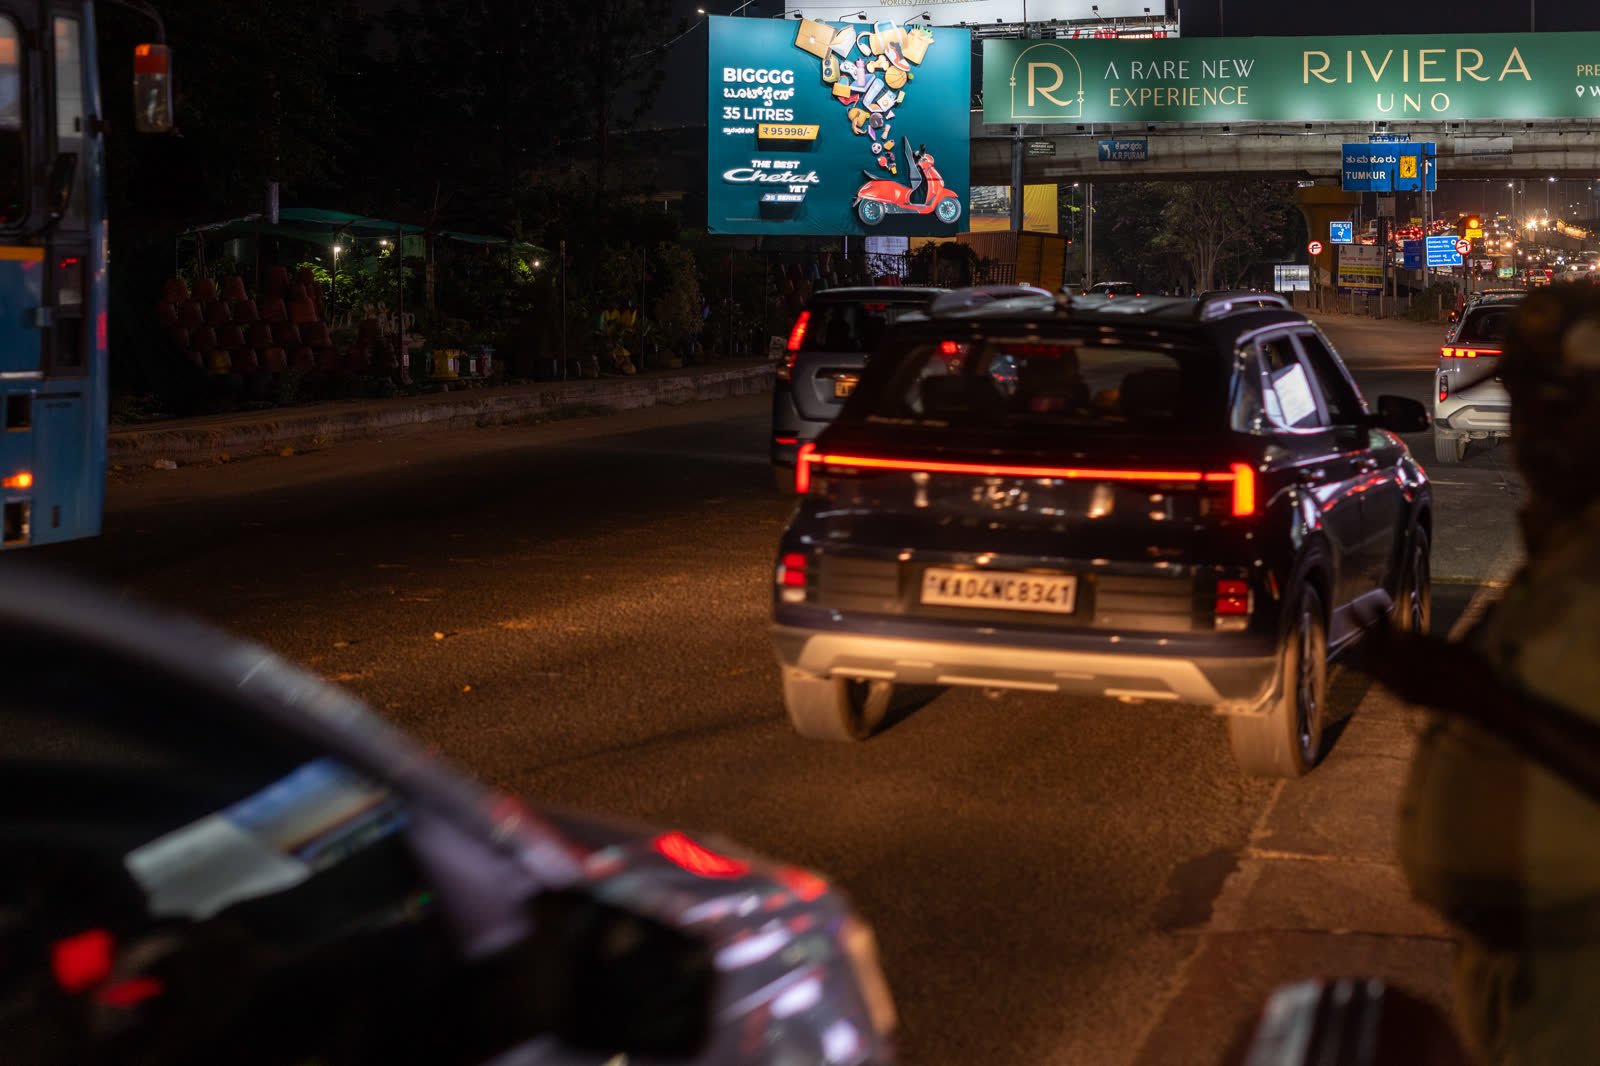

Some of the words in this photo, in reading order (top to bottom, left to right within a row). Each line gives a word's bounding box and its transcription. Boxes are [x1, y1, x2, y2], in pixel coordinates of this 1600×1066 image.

[1104, 61, 1120, 80] A
[1131, 60, 1190, 80] RARE
[1202, 58, 1255, 79] NEW
[1303, 47, 1532, 84] RIVIERA
[723, 67, 795, 85] BIGGGG
[1027, 62, 1074, 107] R
[1110, 86, 1249, 107] EXPERIENCE
[1377, 92, 1450, 113] UNO
[723, 106, 741, 120] 35
[743, 107, 794, 121] LITRES
[751, 160, 772, 169] THE
[773, 160, 800, 169] BEST
[723, 168, 820, 183] Chetak
[1346, 171, 1386, 180] TUMKUR
[788, 185, 809, 193] YET
